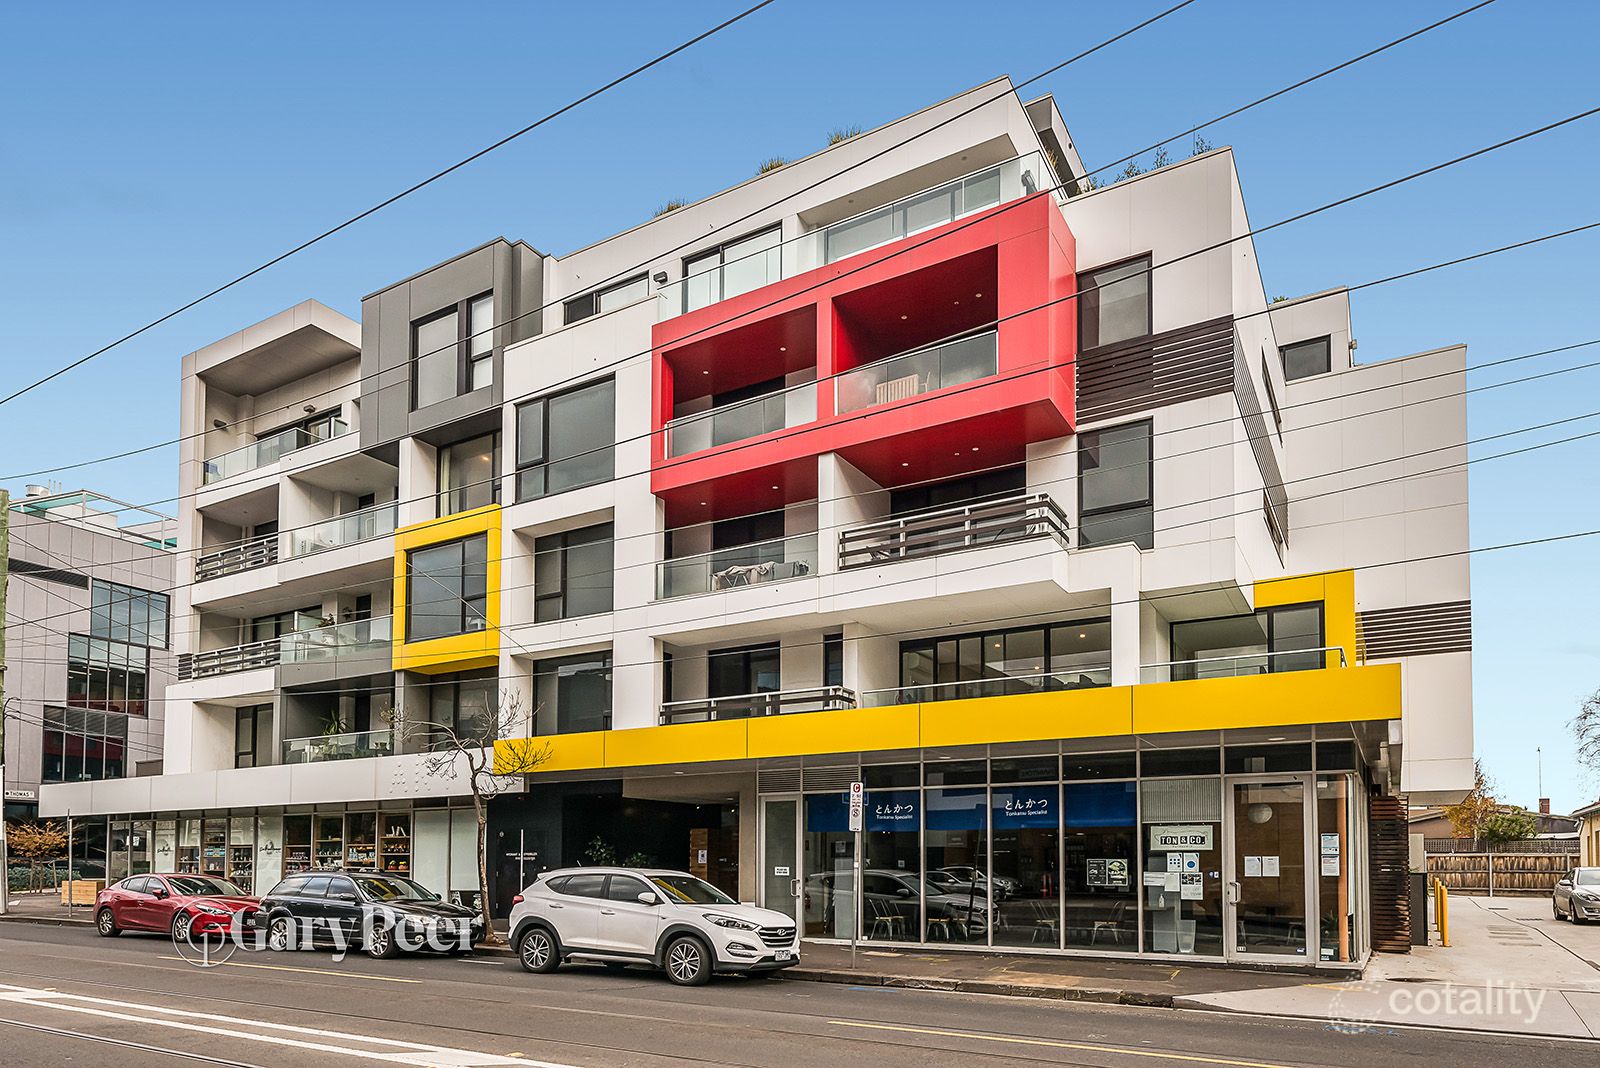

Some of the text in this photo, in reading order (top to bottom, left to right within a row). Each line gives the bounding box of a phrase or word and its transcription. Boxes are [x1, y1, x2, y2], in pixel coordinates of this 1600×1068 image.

[876, 804, 913, 814] とんかつ
[1005, 799, 1048, 810] とんかつ
[1161, 835, 1205, 845] TON & CO.
